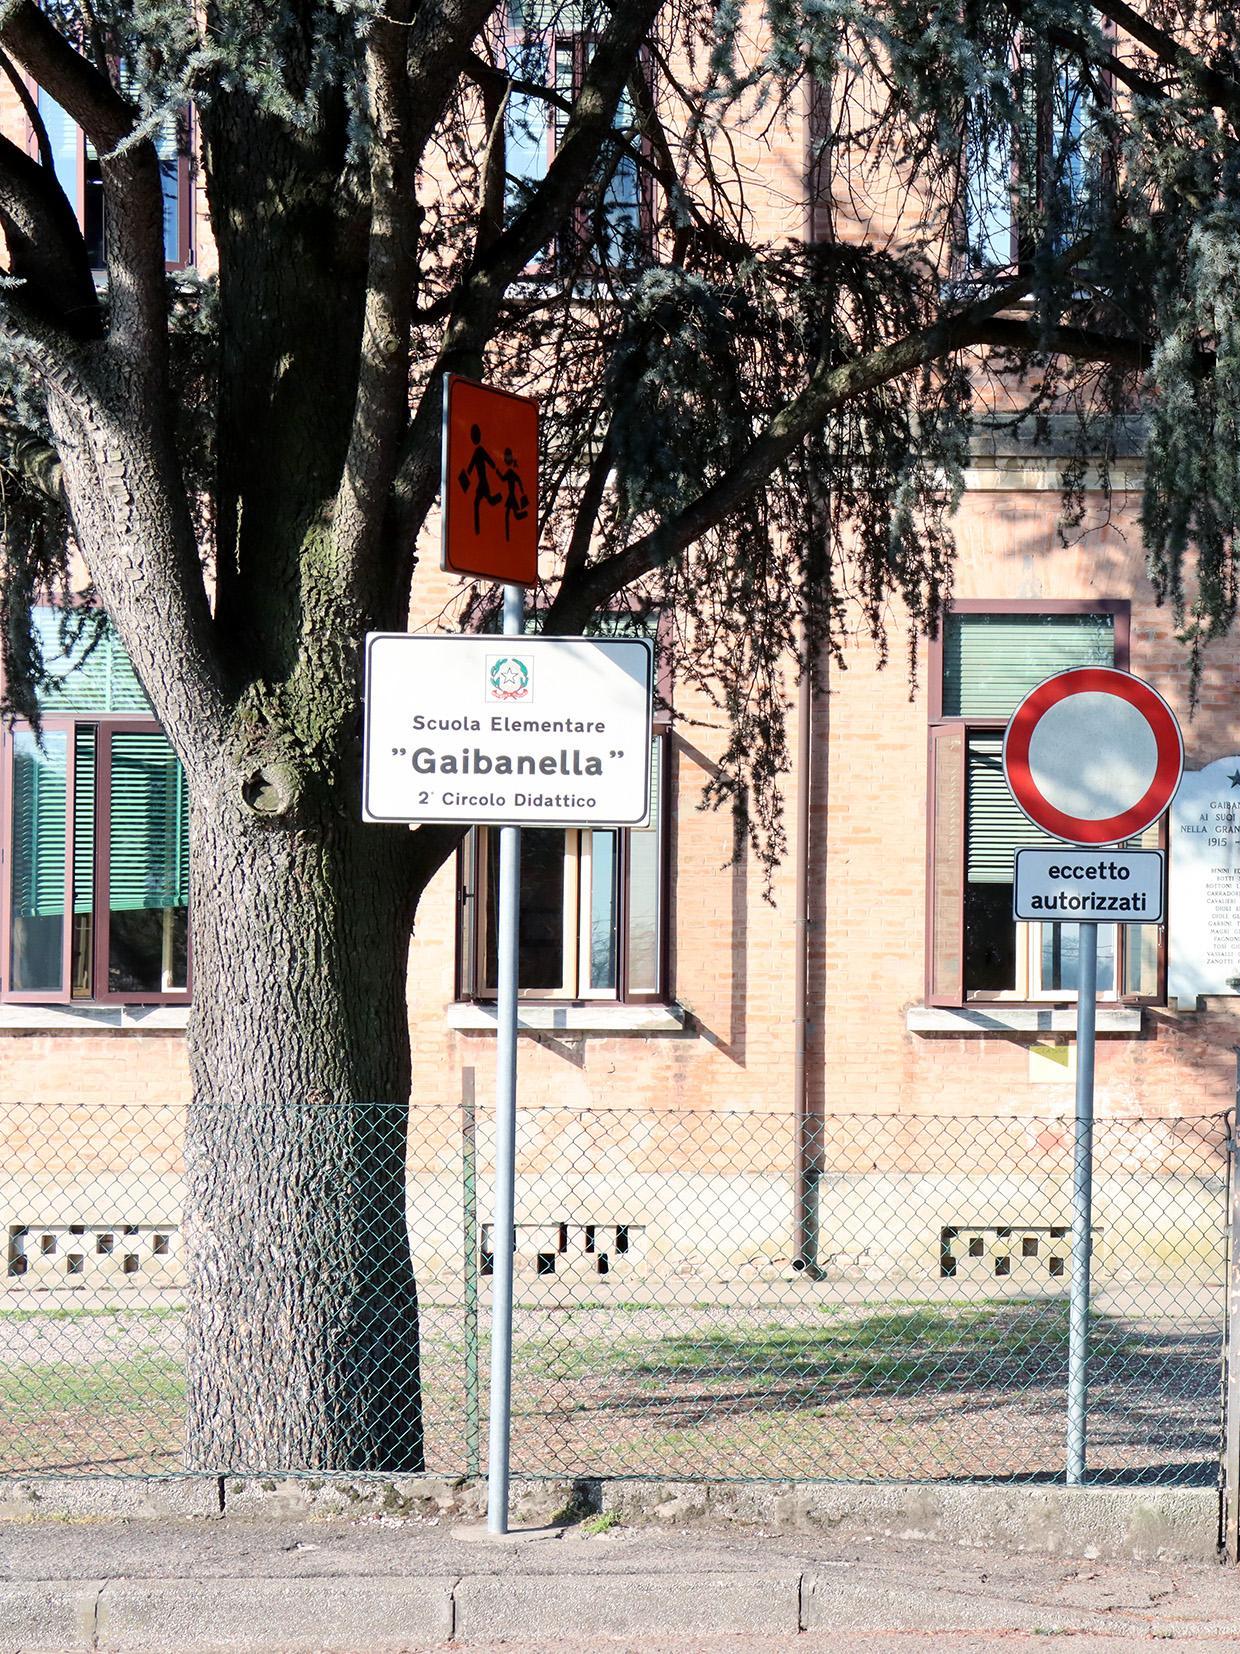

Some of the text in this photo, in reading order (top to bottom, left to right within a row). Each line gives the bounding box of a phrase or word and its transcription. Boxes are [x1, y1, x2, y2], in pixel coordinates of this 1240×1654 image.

[412, 715, 606, 733] Scuola Elementare
[442, 792, 506, 807] Circolo
[514, 793, 597, 808] Didattico
[1200, 813, 1208, 821] AI
[1216, 813, 1235, 821] SUOI
[1180, 825, 1207, 833] NELLA
[1207, 837, 1227, 847] 1915
[1048, 862, 1130, 880] eccetto
[1031, 892, 1146, 911] autorizzati
